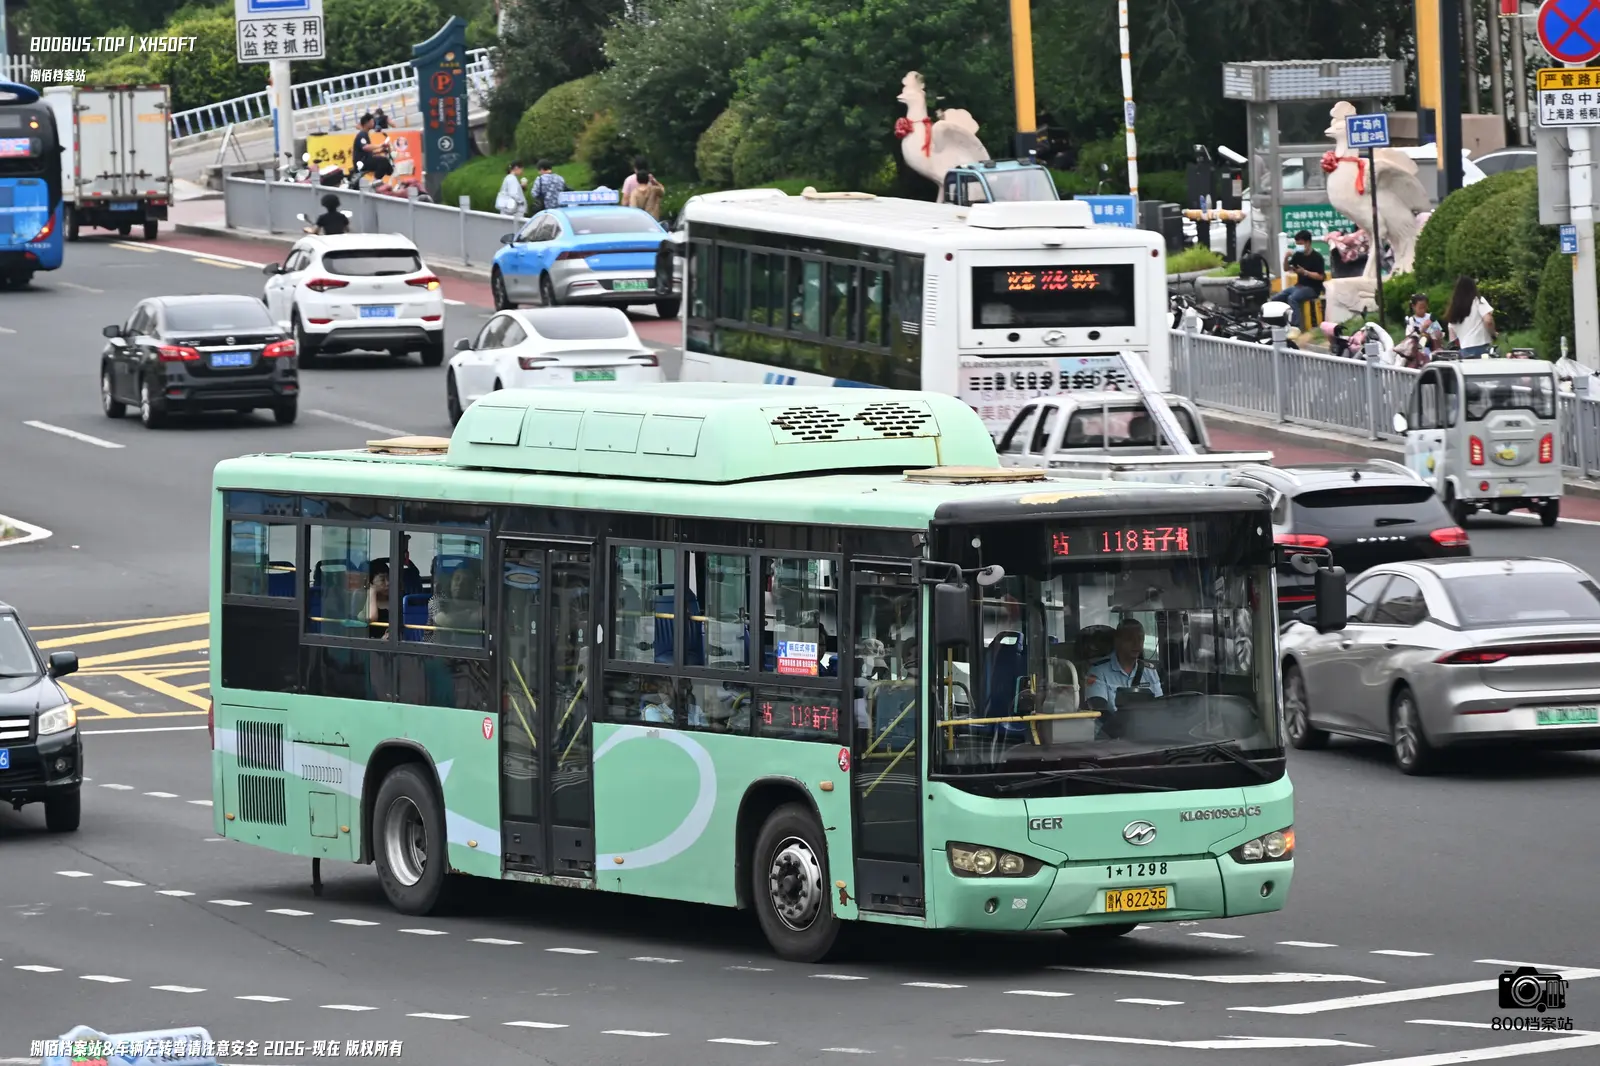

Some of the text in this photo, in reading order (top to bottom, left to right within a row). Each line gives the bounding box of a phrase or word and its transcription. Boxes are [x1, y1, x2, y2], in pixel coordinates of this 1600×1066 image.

[242, 20, 318, 38] 公交专用
[243, 38, 319, 56] 监控抓拍
[1546, 107, 1600, 121] 上海路-梧桐
[1353, 118, 1382, 131] 广场内
[1179, 805, 1262, 823] KLQ6109GAC5
[1029, 817, 1063, 831] GER
